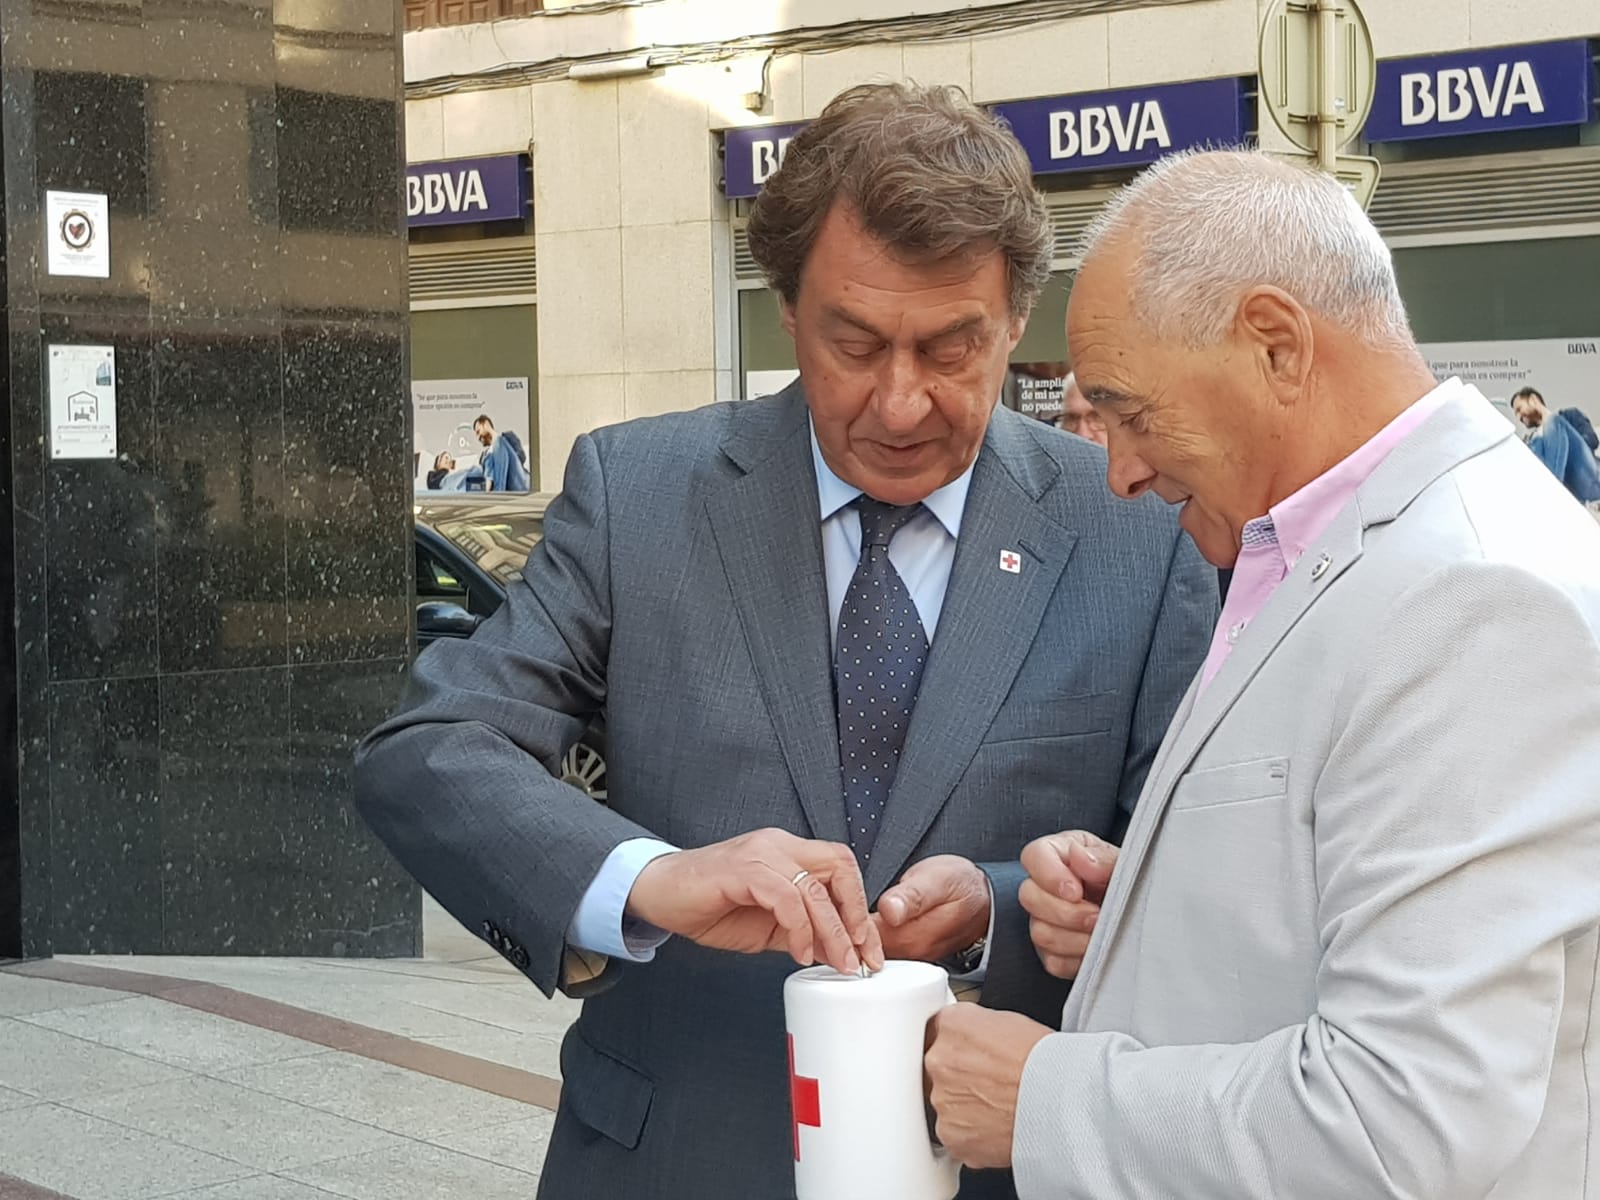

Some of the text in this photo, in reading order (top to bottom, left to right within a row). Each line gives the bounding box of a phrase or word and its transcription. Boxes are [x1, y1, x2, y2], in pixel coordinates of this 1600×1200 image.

[1400, 61, 1545, 126] BBVA
[1049, 100, 1171, 160] BBVA
[751, 137, 794, 184] B
[406, 169, 489, 216] BBVA
[1567, 343, 1597, 354] BBVA
[1021, 390, 1034, 400] de
[1034, 389, 1048, 400] mi
[1021, 403, 1034, 412] no
